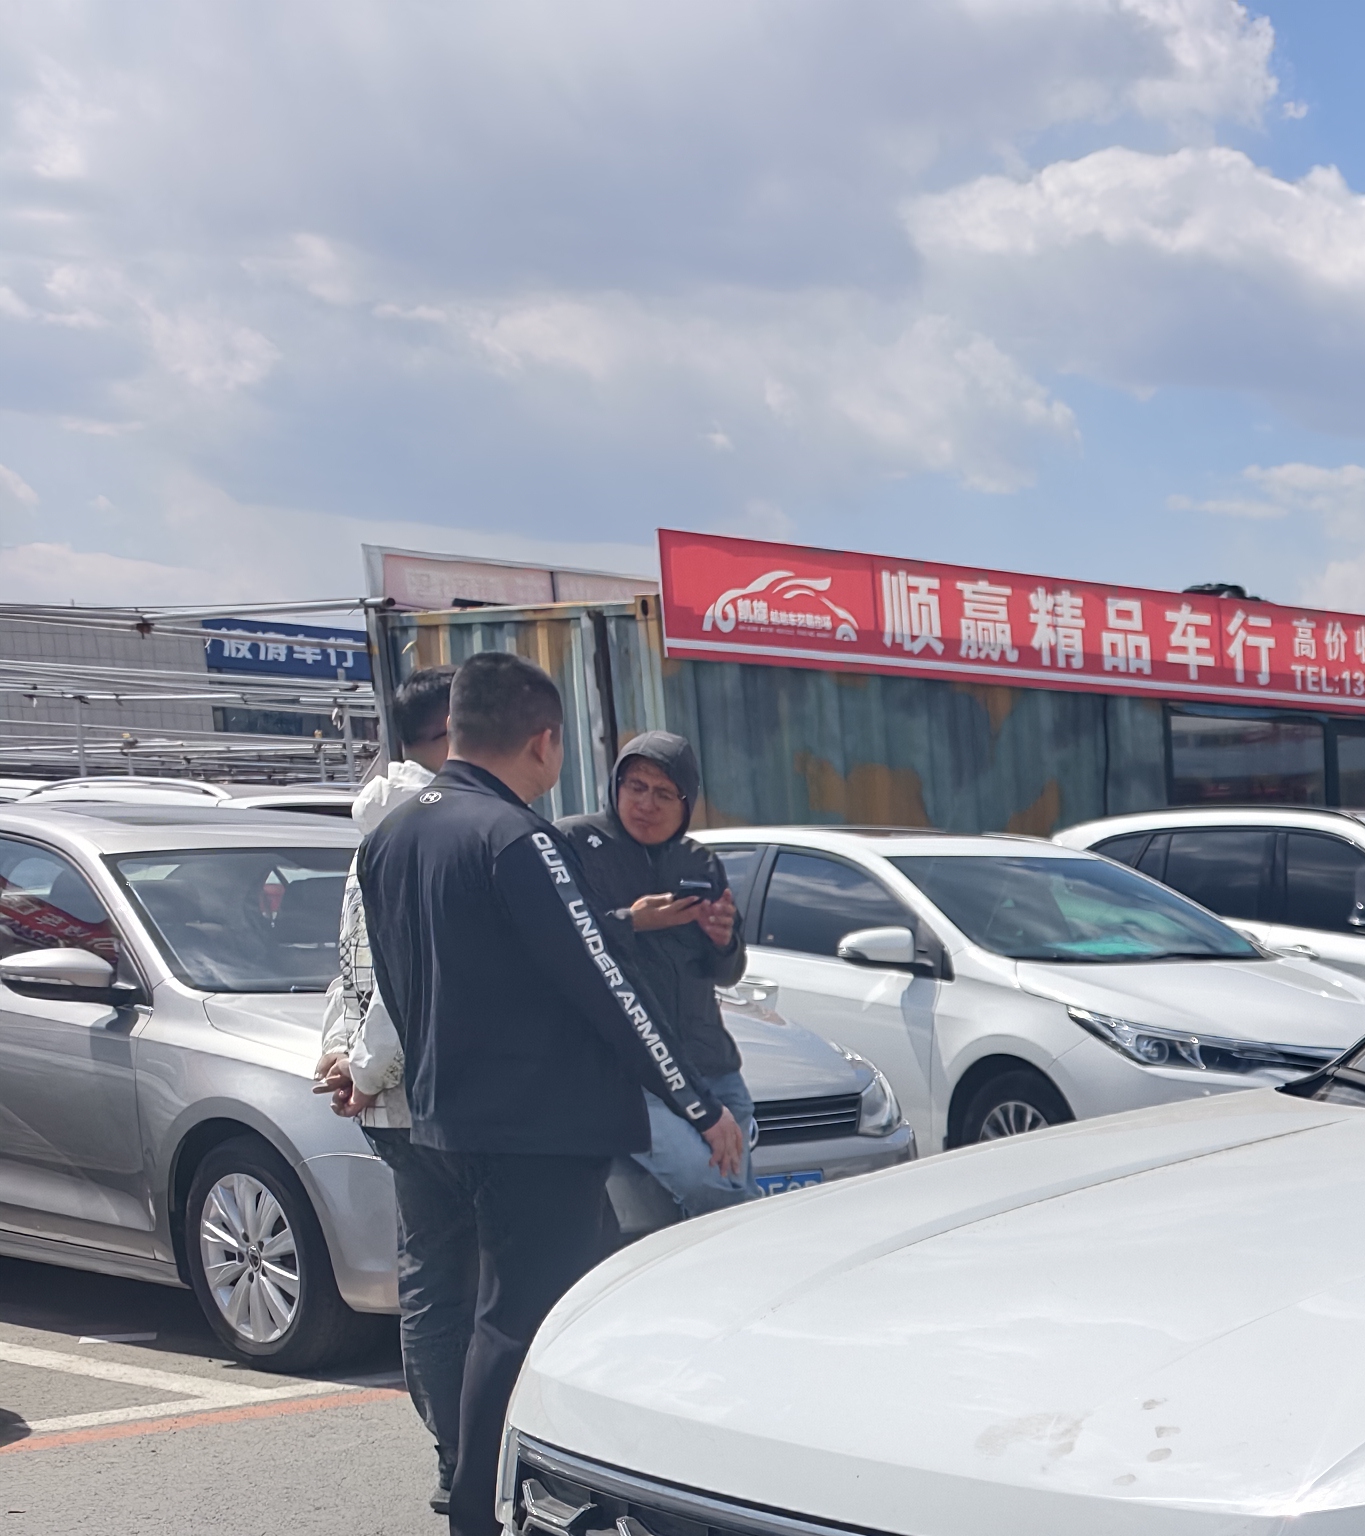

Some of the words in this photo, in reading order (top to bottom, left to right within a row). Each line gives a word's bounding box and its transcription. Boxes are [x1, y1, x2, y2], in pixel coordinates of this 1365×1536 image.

[881, 569, 1276, 686] 顺赢精品车行
[568, 899, 625, 988] UNDER
[616, 990, 687, 1093] ARMOUR
